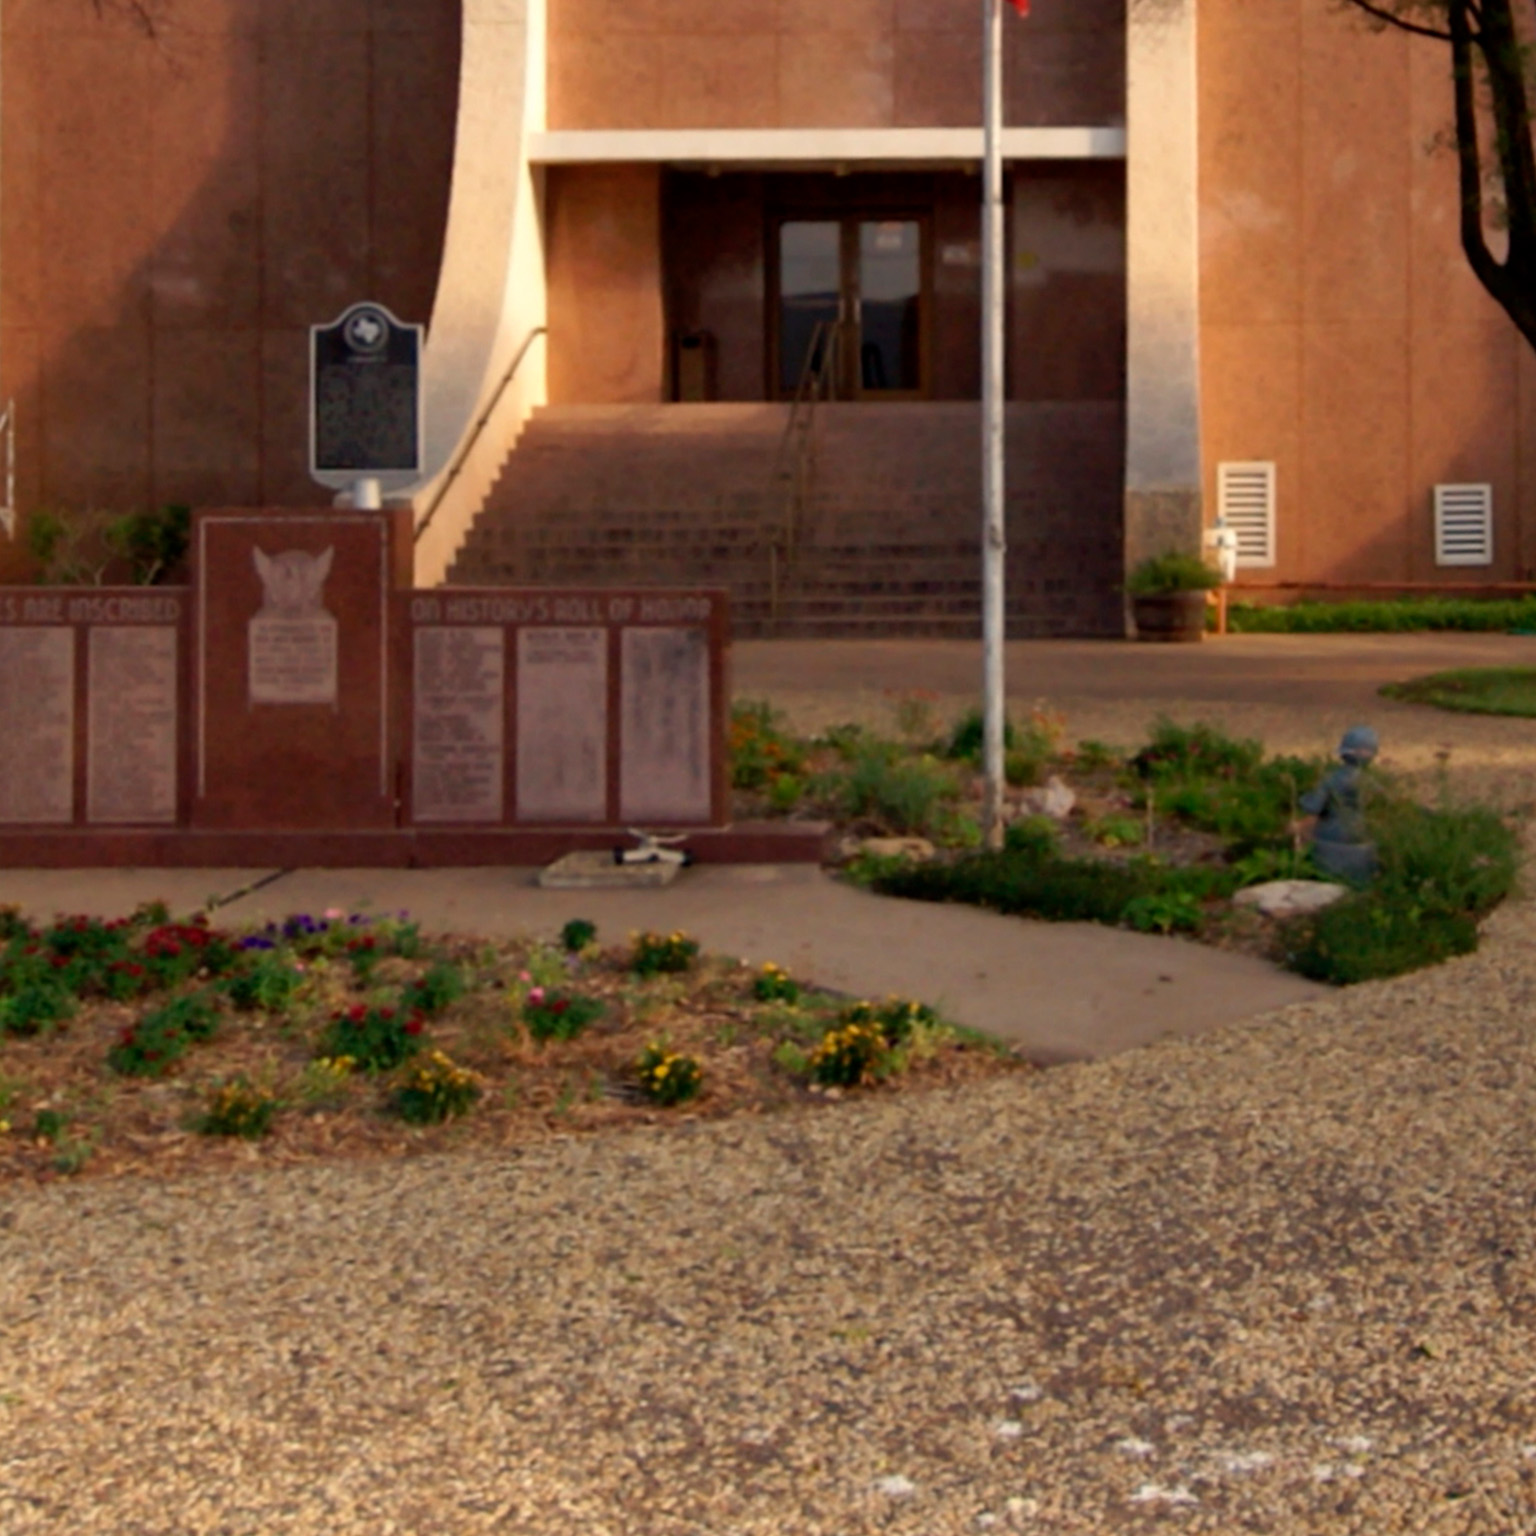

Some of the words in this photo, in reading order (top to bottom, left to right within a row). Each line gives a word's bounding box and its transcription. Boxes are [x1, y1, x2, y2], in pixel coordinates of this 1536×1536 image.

[23, 597, 63, 622] ARE
[68, 597, 181, 622] INSCRIBED
[411, 597, 440, 622] ON
[554, 597, 603, 622] ROLL
[609, 597, 633, 622] OF
